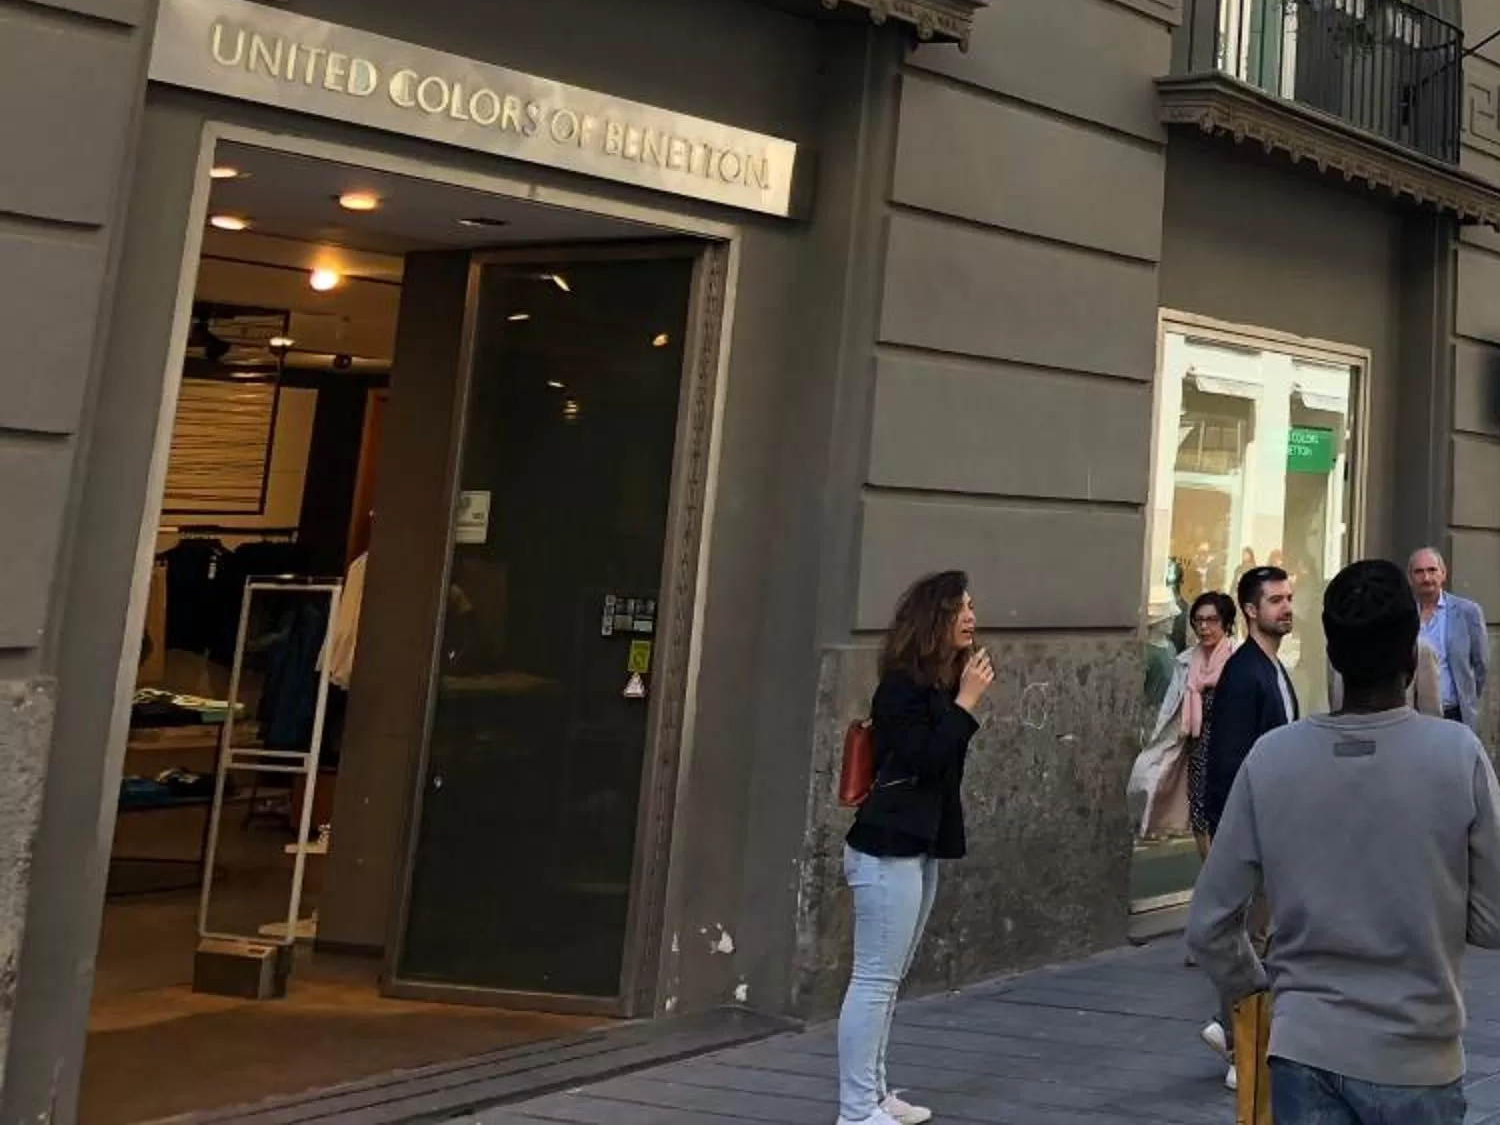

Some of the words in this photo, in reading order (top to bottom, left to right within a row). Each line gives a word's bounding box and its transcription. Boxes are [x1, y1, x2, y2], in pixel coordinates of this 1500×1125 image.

[211, 23, 377, 96] UNITED
[388, 68, 541, 138] COLORS
[550, 108, 597, 148] OF
